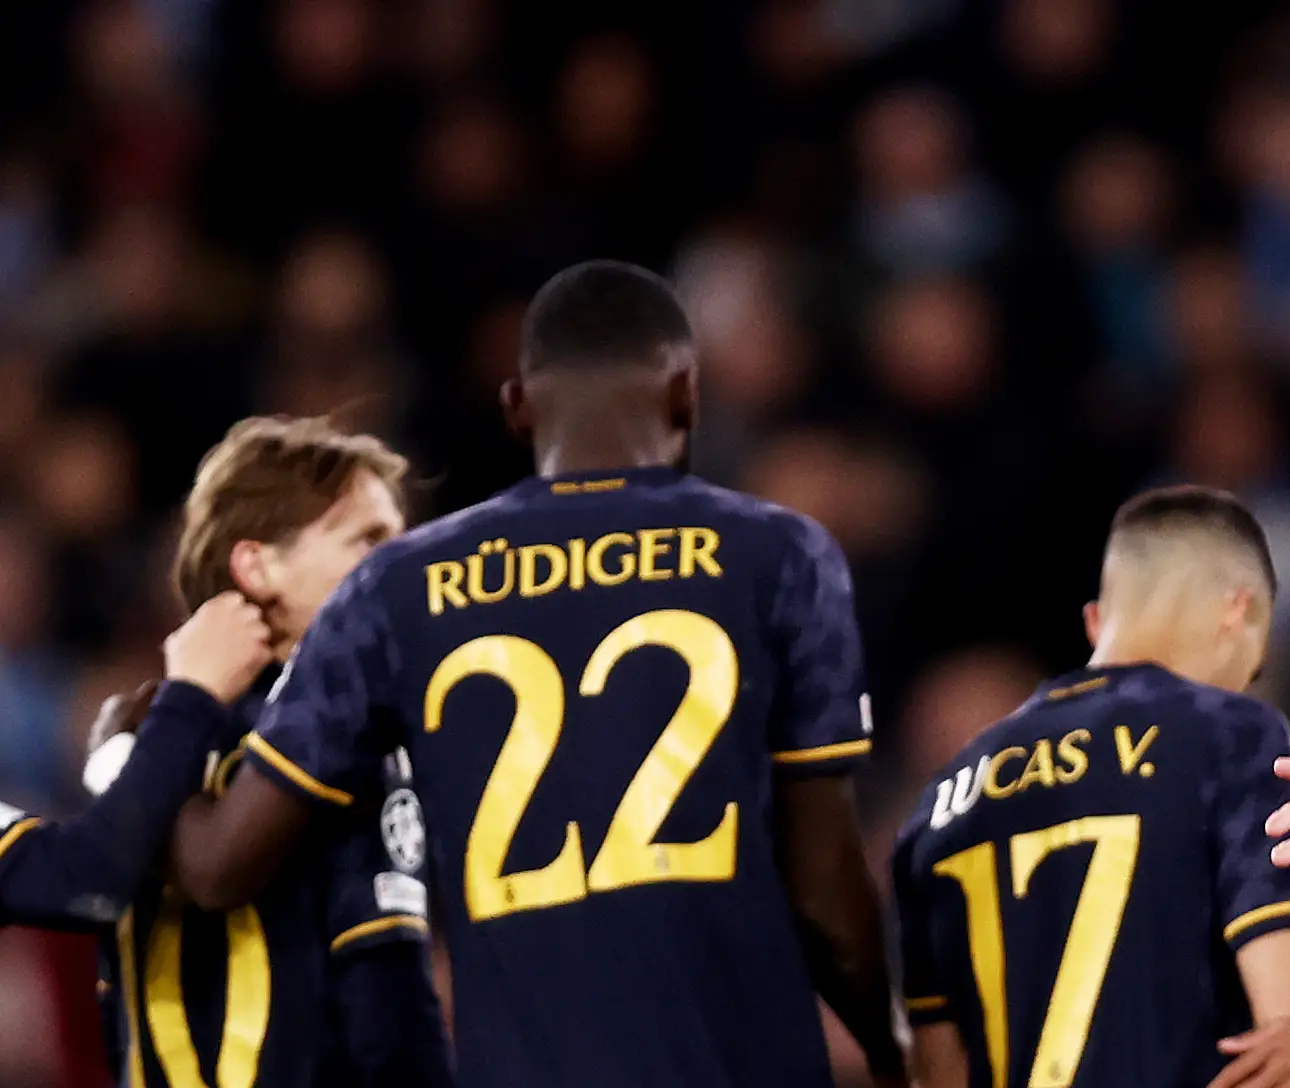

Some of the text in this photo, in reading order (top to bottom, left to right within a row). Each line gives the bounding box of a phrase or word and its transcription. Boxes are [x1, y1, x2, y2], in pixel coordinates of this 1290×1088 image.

[425, 526, 724, 616] RÜDIGER
[422, 608, 740, 923] 22
[929, 724, 1160, 830] LUCAS V.
